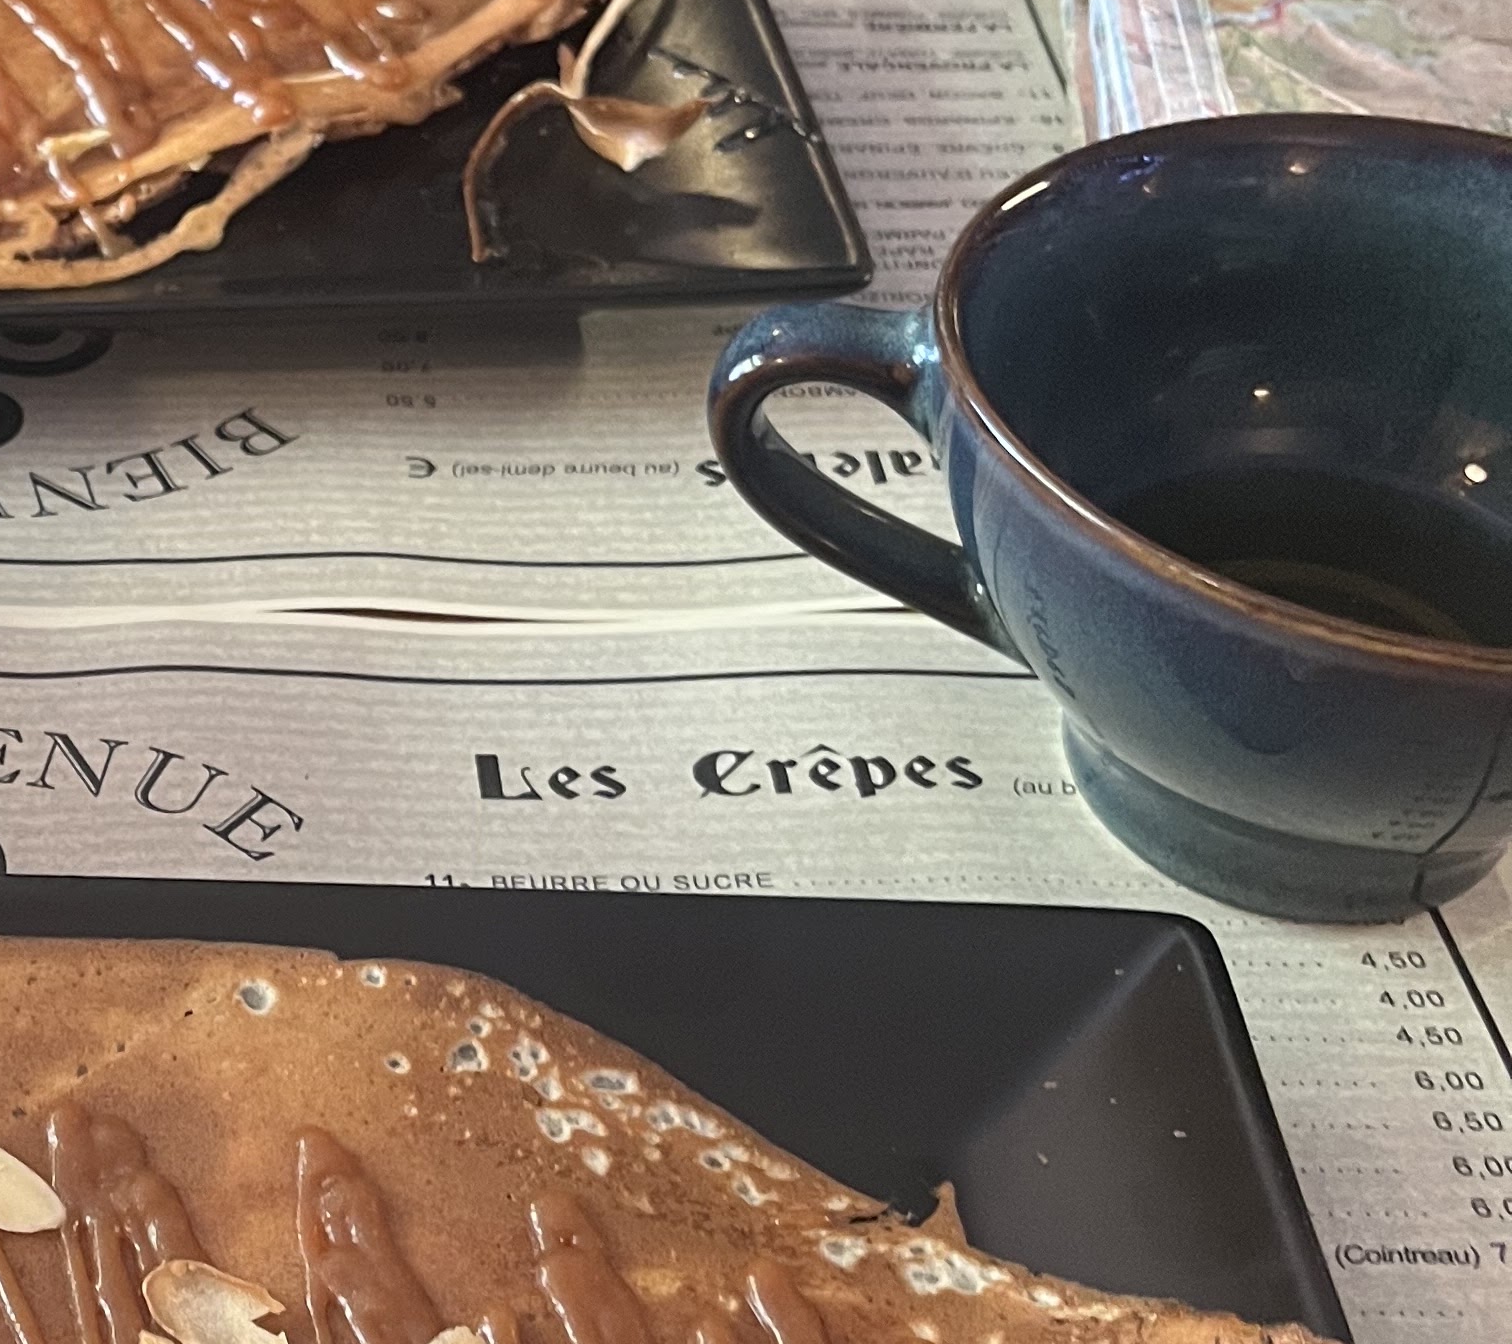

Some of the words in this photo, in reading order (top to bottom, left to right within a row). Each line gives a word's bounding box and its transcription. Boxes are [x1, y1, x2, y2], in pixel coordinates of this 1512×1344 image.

[475, 753, 627, 801] Les
[692, 744, 984, 799] Crêpes
[1013, 776, 1052, 798] (au
[490, 874, 611, 892] BEURRE
[620, 874, 661, 892] OU
[673, 872, 775, 891] SUCRE
[1334, 1242, 1481, 1270] (Cointreau)
